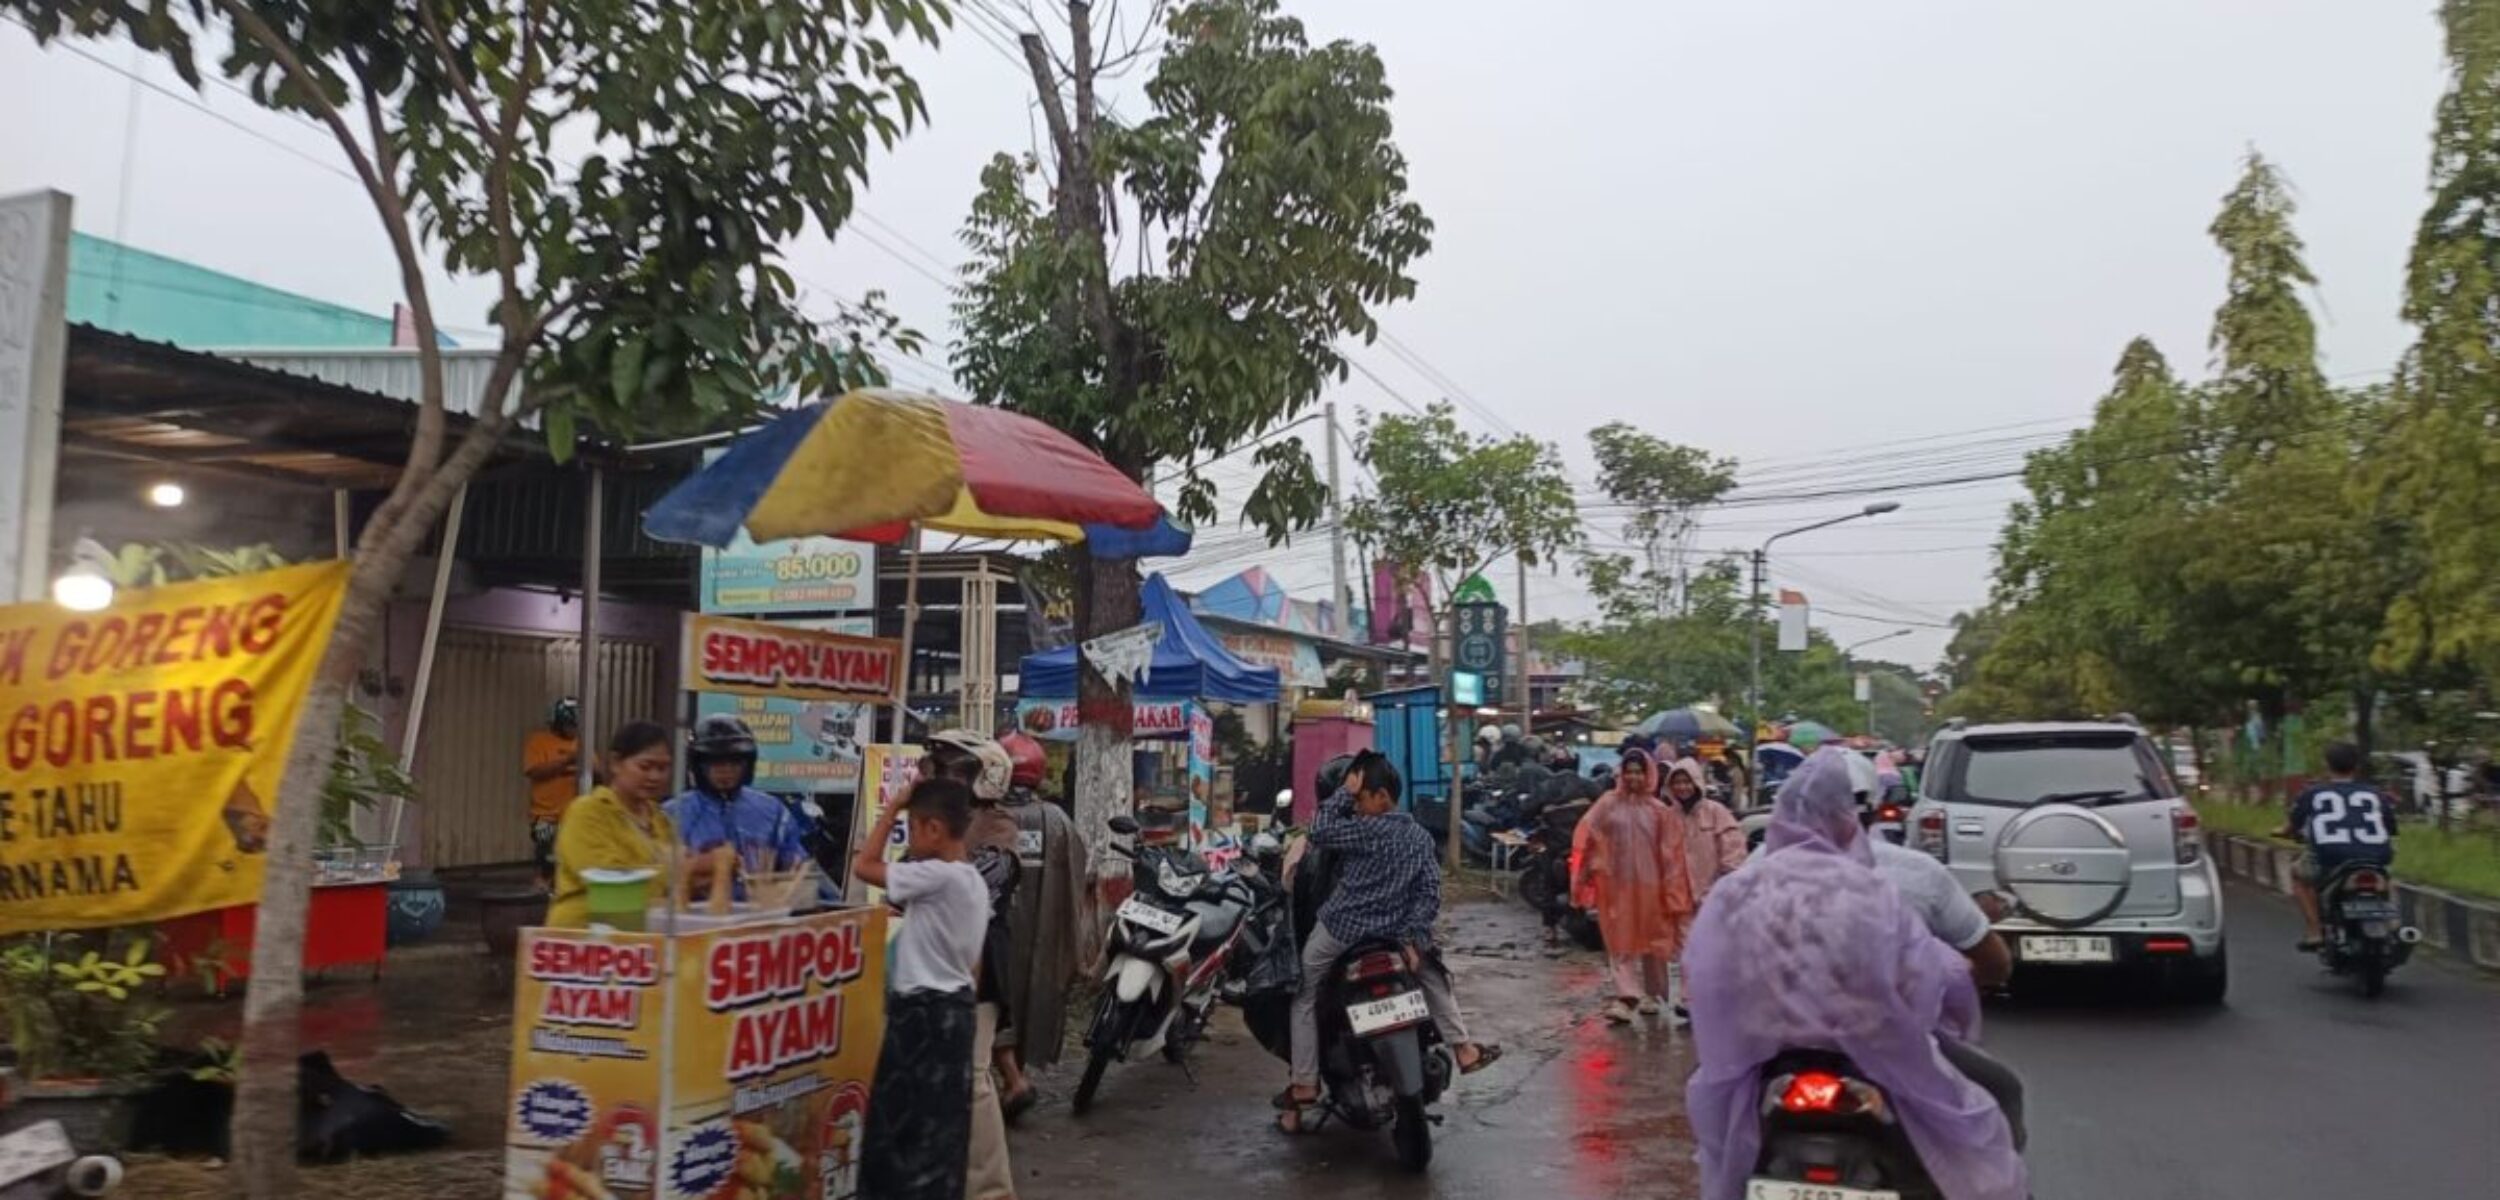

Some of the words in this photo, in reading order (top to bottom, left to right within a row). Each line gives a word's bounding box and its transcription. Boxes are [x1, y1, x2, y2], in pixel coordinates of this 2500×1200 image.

[47, 594, 288, 681] GORENG
[702, 632, 818, 683] SEMPOL
[819, 648, 890, 689] AYAM
[7, 679, 256, 771] GORENG
[2312, 790, 2388, 844] 23
[0, 853, 140, 902] RNAMA
[532, 940, 656, 982] SEMPOL
[709, 923, 860, 1003] SEMPOL
[546, 985, 635, 1024] AYAM
[728, 992, 839, 1072] AYAM
